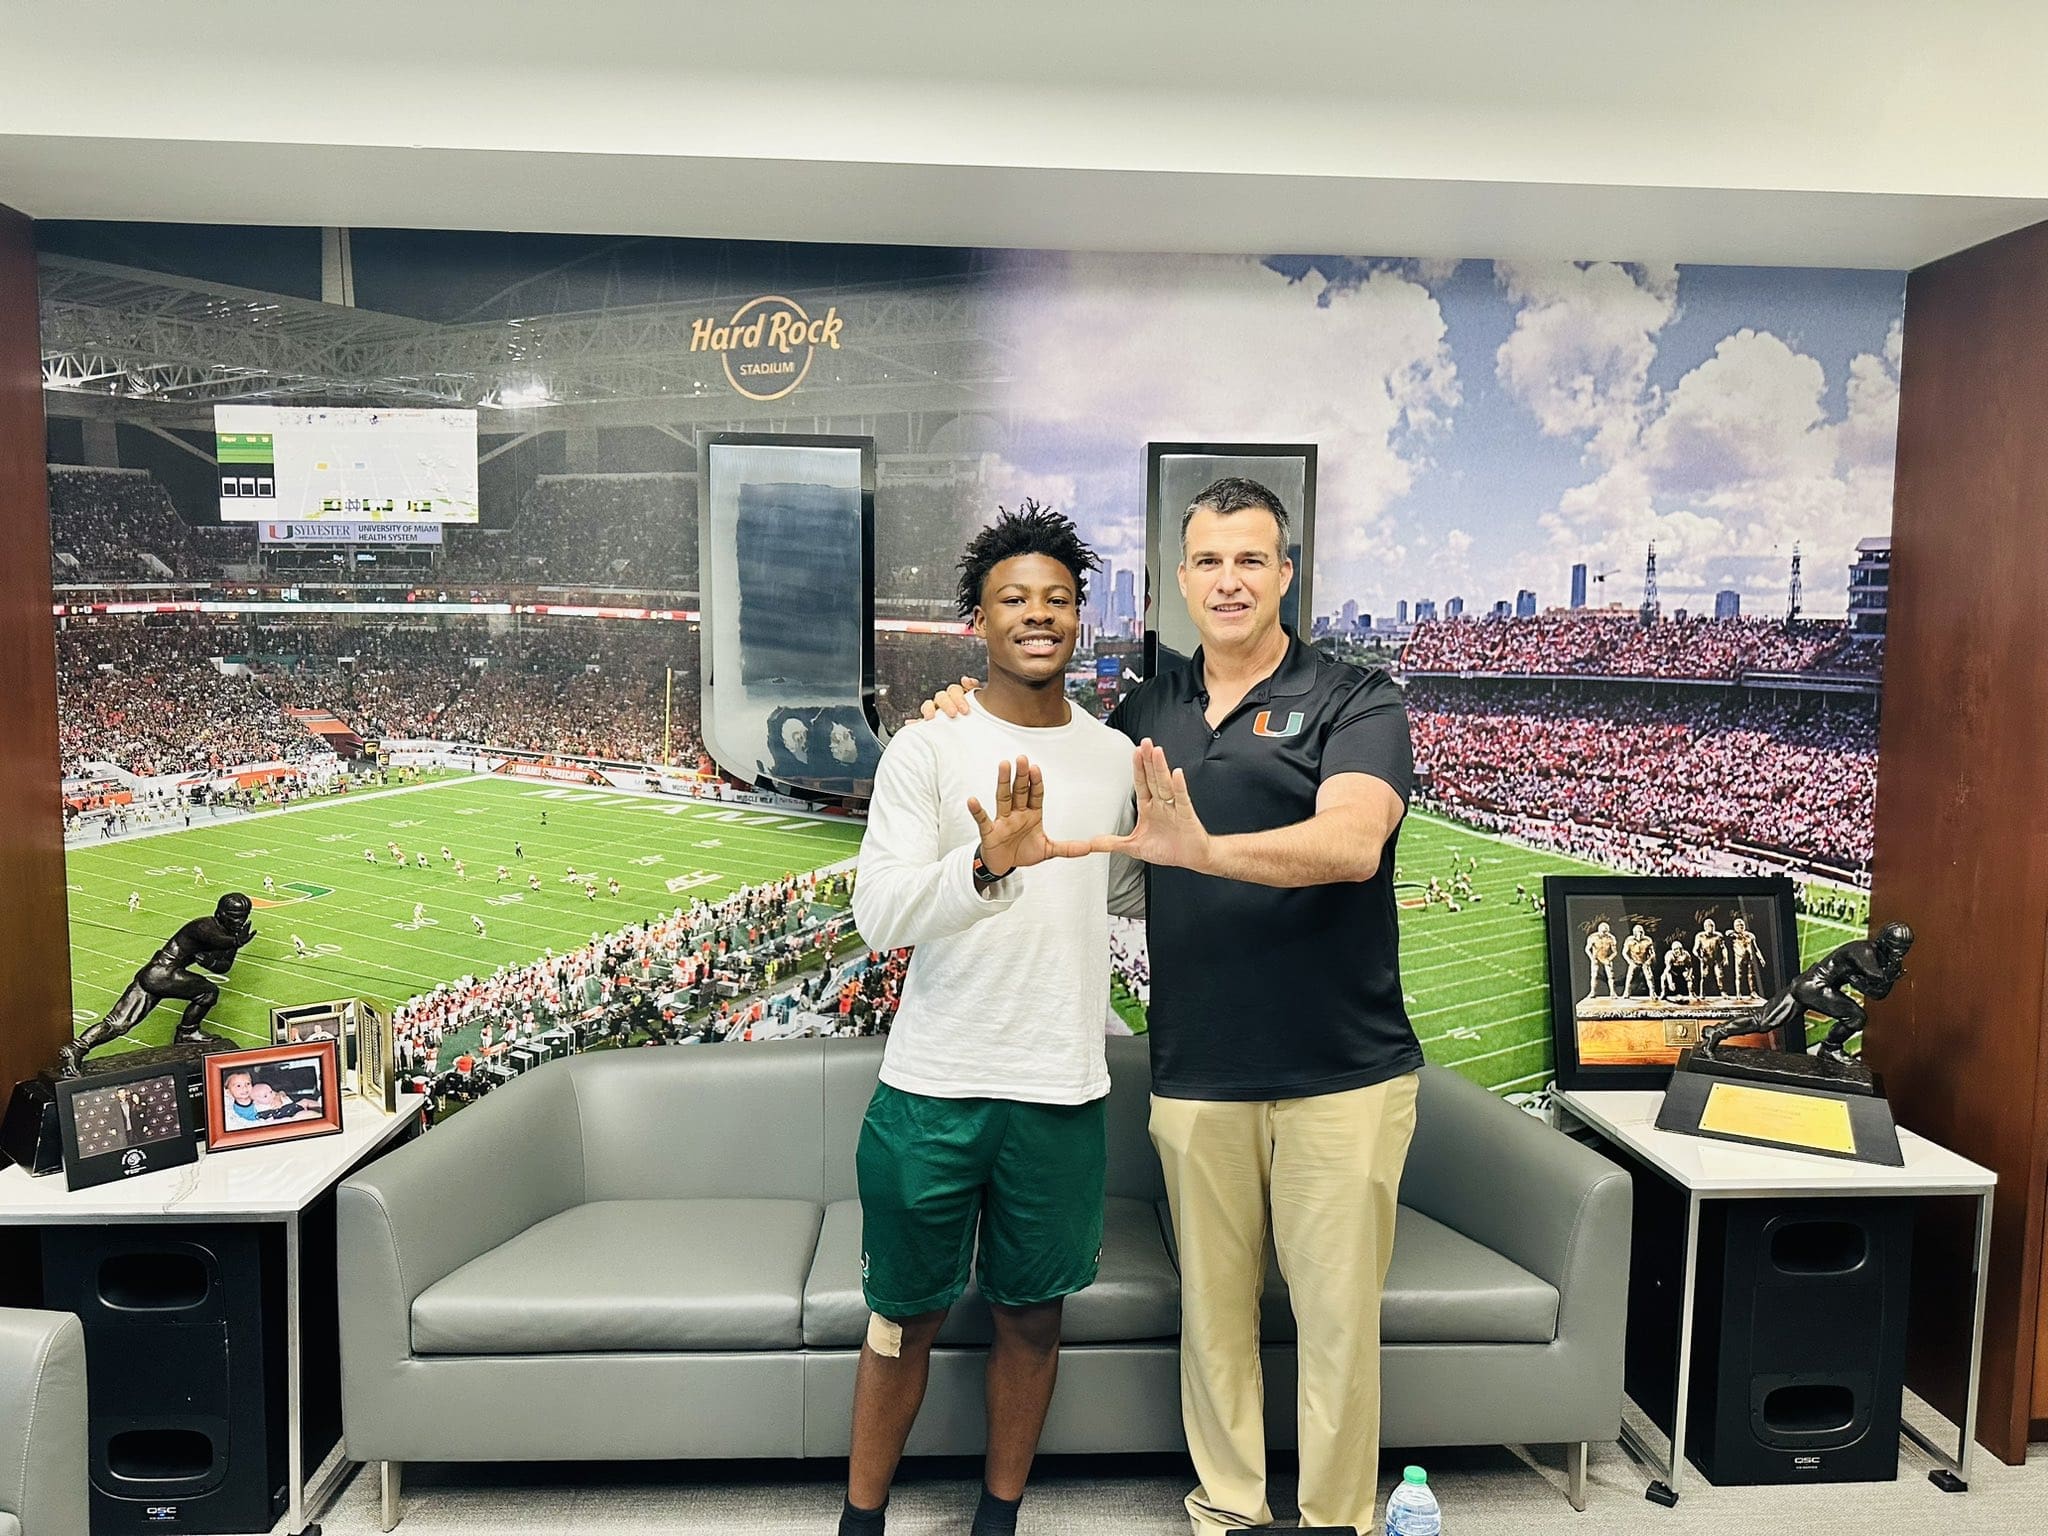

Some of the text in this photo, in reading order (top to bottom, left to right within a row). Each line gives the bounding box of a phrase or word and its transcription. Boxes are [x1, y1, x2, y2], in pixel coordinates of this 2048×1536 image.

[690, 307, 844, 353] Hard Rock
[739, 361, 795, 376] STADIUM
[294, 524, 351, 536] SYLVESTER
[358, 524, 439, 533] UNIVERSITY OF MIAMI
[358, 533, 387, 541] HEALTH
[388, 533, 418, 541] SYSTEM
[1252, 710, 1305, 738] U
[519, 788, 824, 830] MIAMI
[1794, 1456, 1821, 1464] QSC
[147, 1506, 177, 1514] QSC
